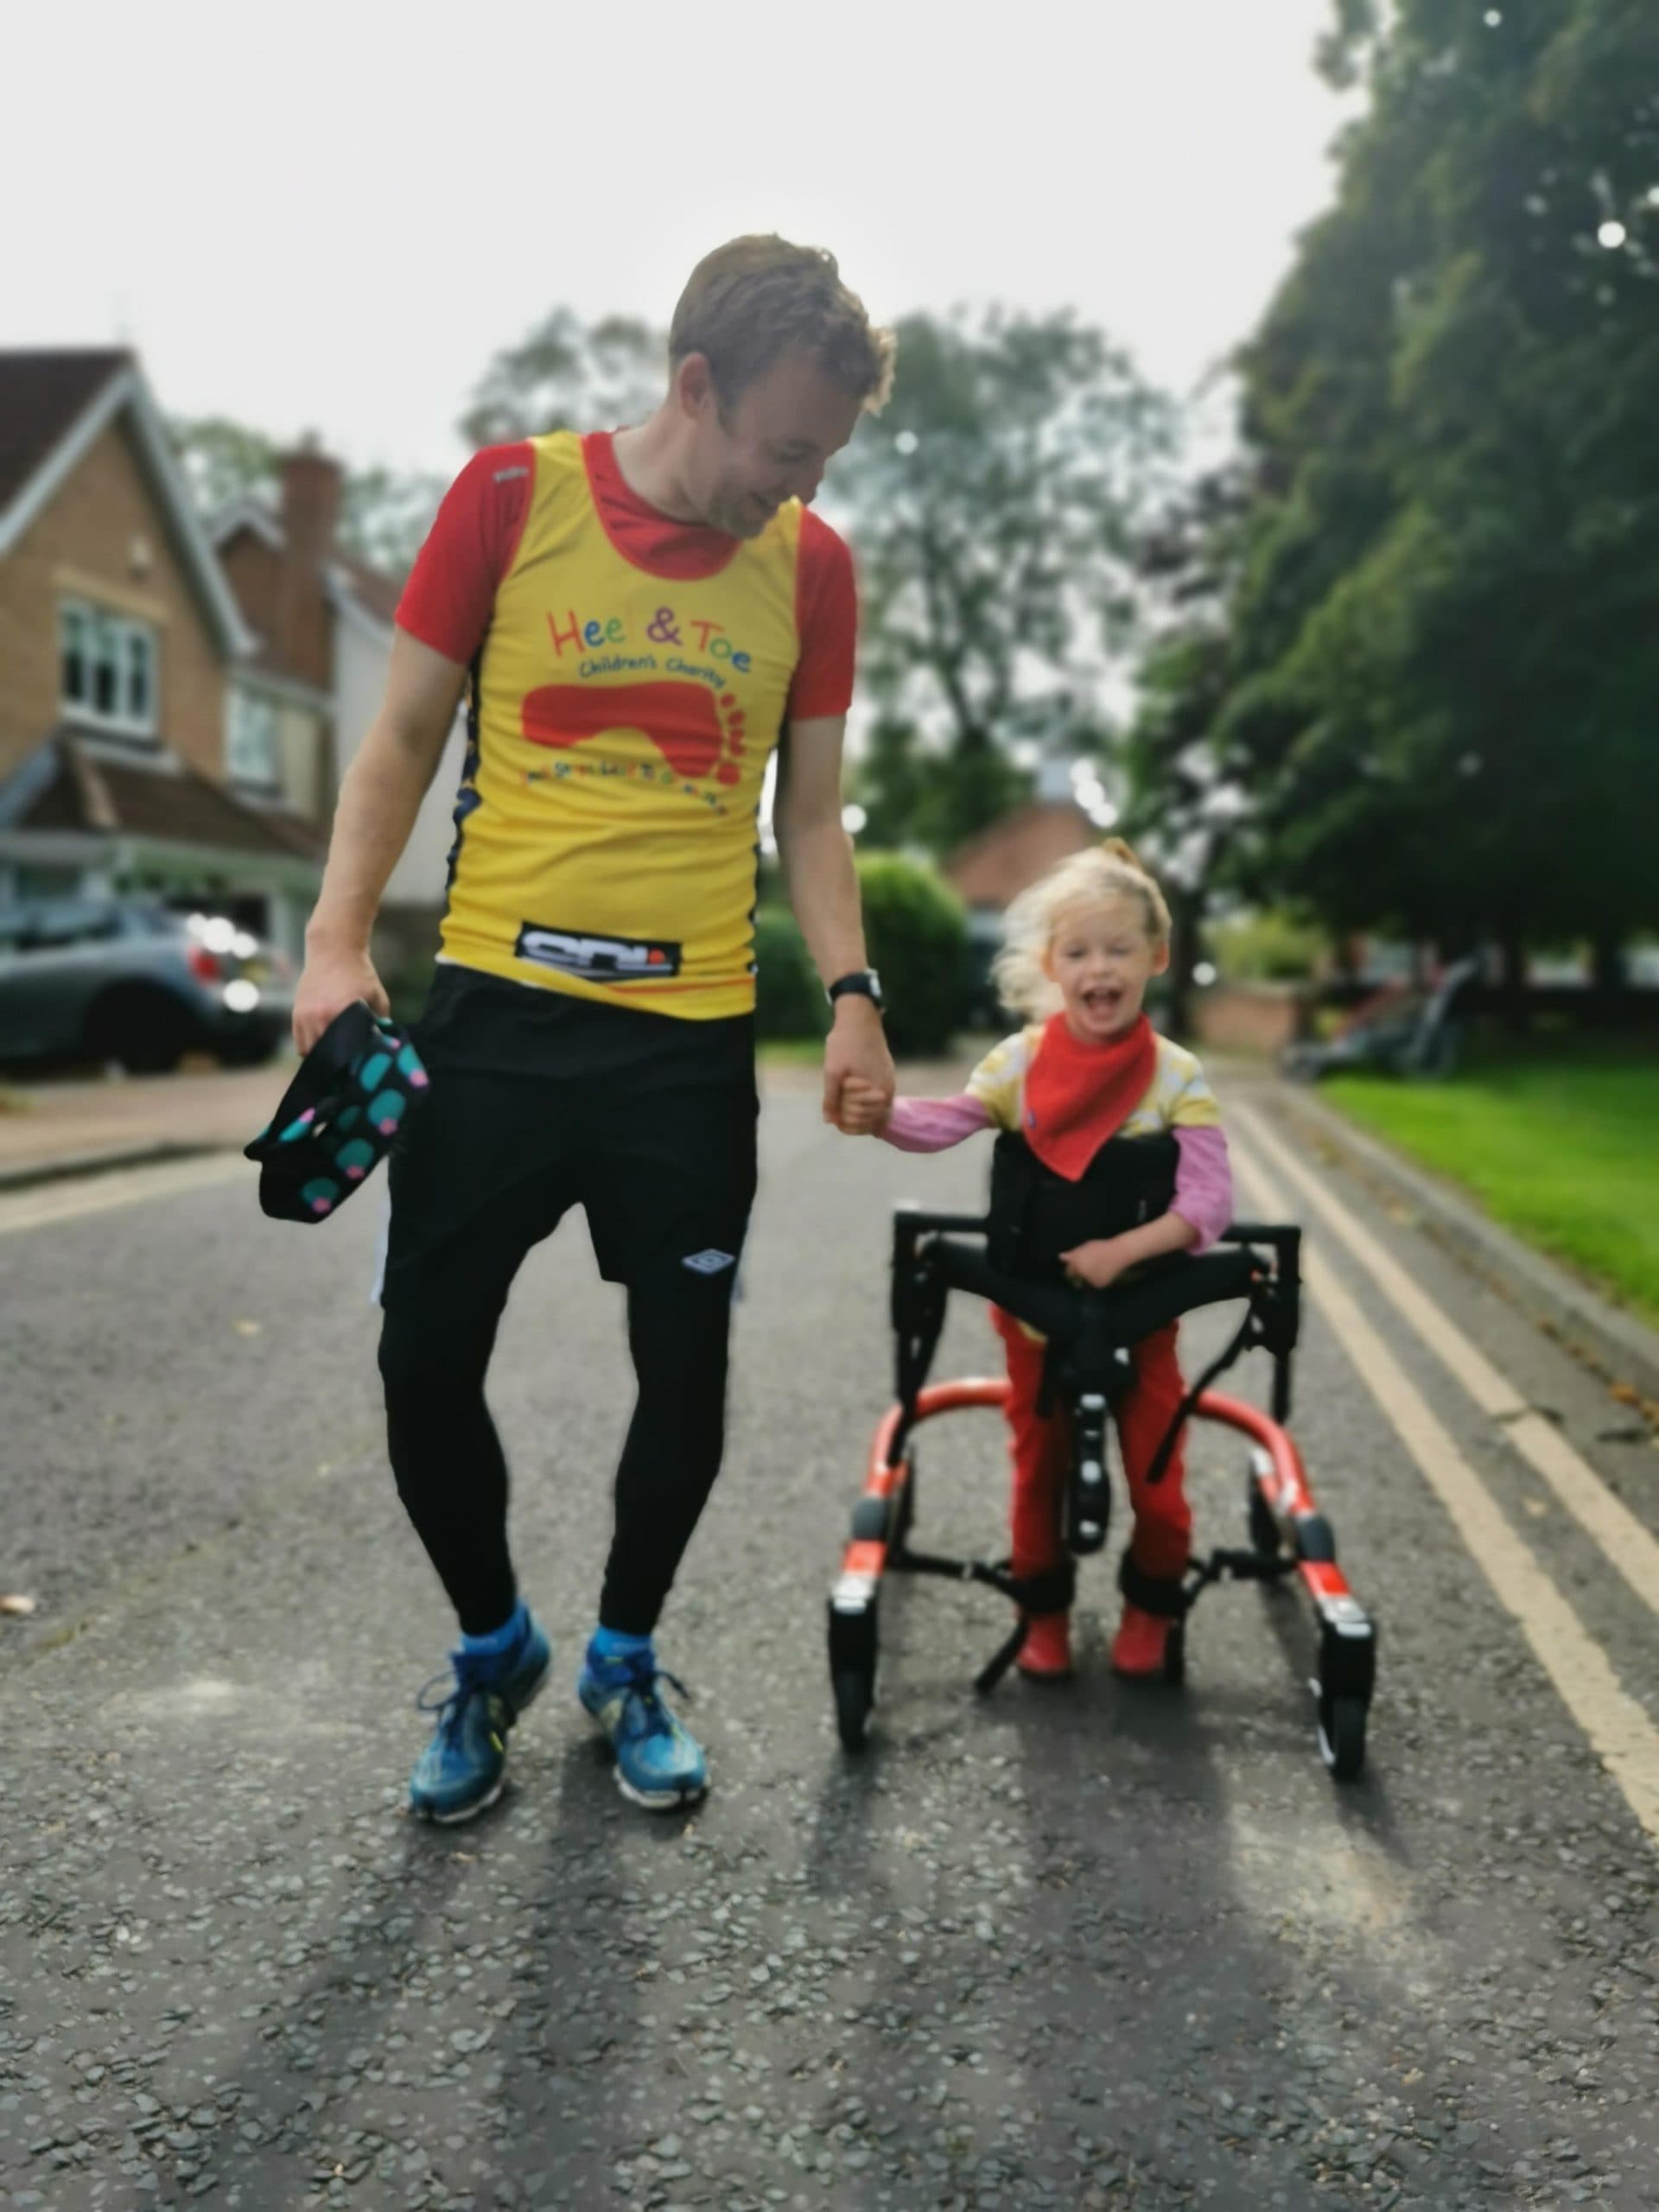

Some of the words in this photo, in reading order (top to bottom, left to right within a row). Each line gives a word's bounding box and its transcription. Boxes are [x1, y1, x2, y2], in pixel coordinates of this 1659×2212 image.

[646, 607, 683, 646] &
[690, 619, 752, 673] Toe
[665, 658, 727, 690] Charity
